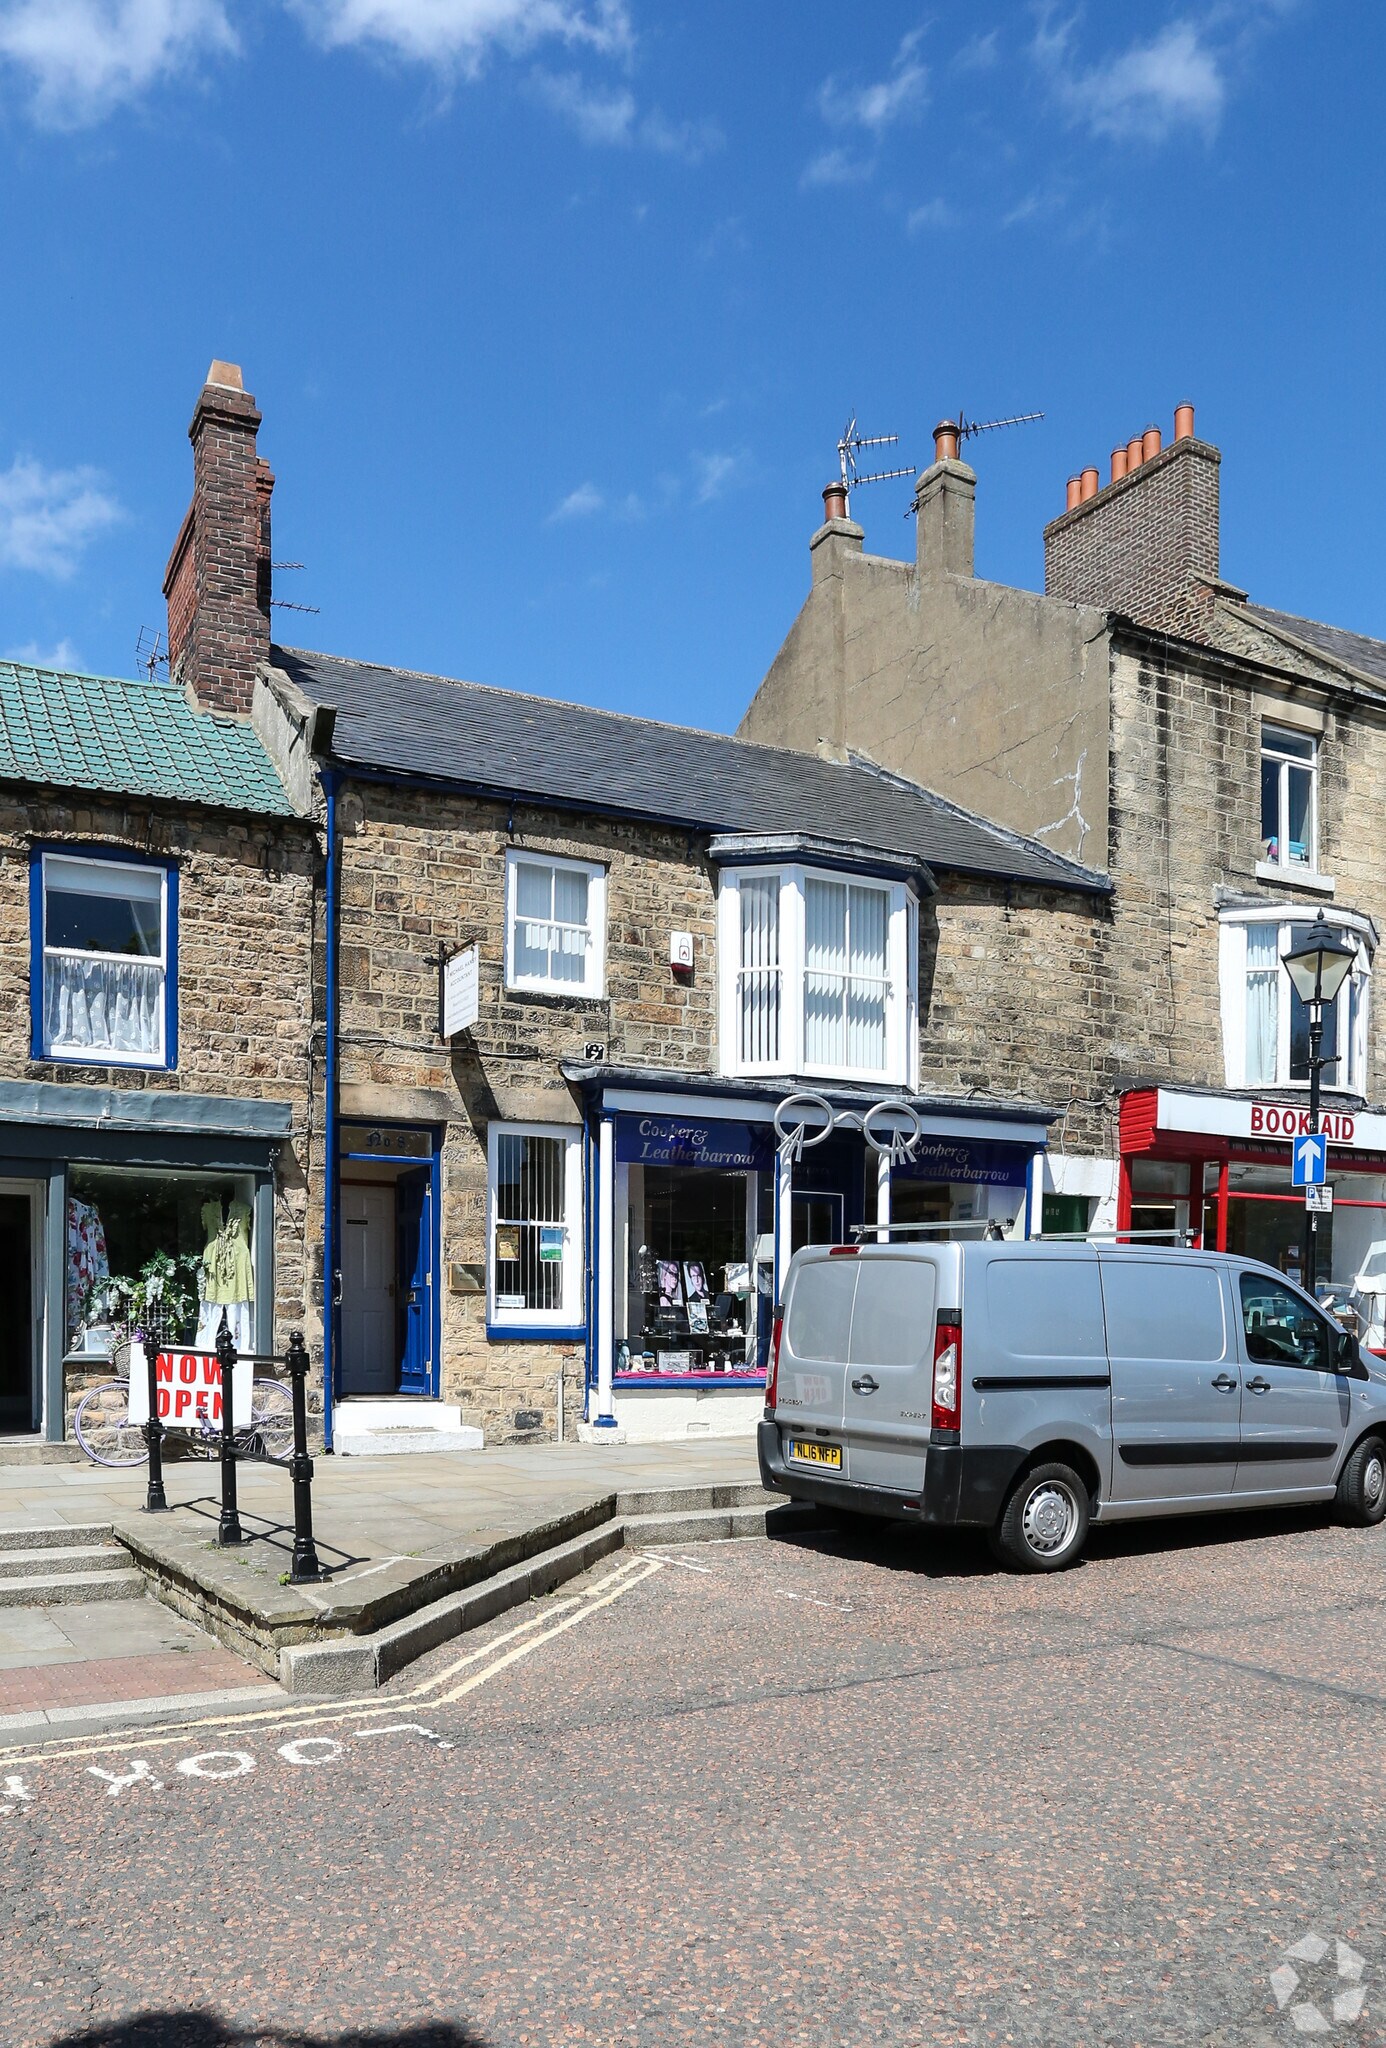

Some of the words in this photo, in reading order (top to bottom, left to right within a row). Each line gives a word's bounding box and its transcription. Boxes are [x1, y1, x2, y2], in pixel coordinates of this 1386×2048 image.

[639, 1119, 693, 1142] Cooper
[691, 1129, 708, 1145] &
[1251, 1107, 1310, 1135] BOOK
[1321, 1114, 1354, 1140] AID
[640, 1141, 755, 1165] Leatherbarrow
[912, 1140, 957, 1161] Cooper
[955, 1148, 969, 1163] &
[912, 1162, 1010, 1181] Leatherbarrow
[155, 1353, 223, 1386] NOW
[157, 1388, 224, 1420] OPEN
[900, 1411, 926, 1419] EXPERT
[797, 1443, 817, 1460] NL16
[818, 1447, 837, 1463] NFP
